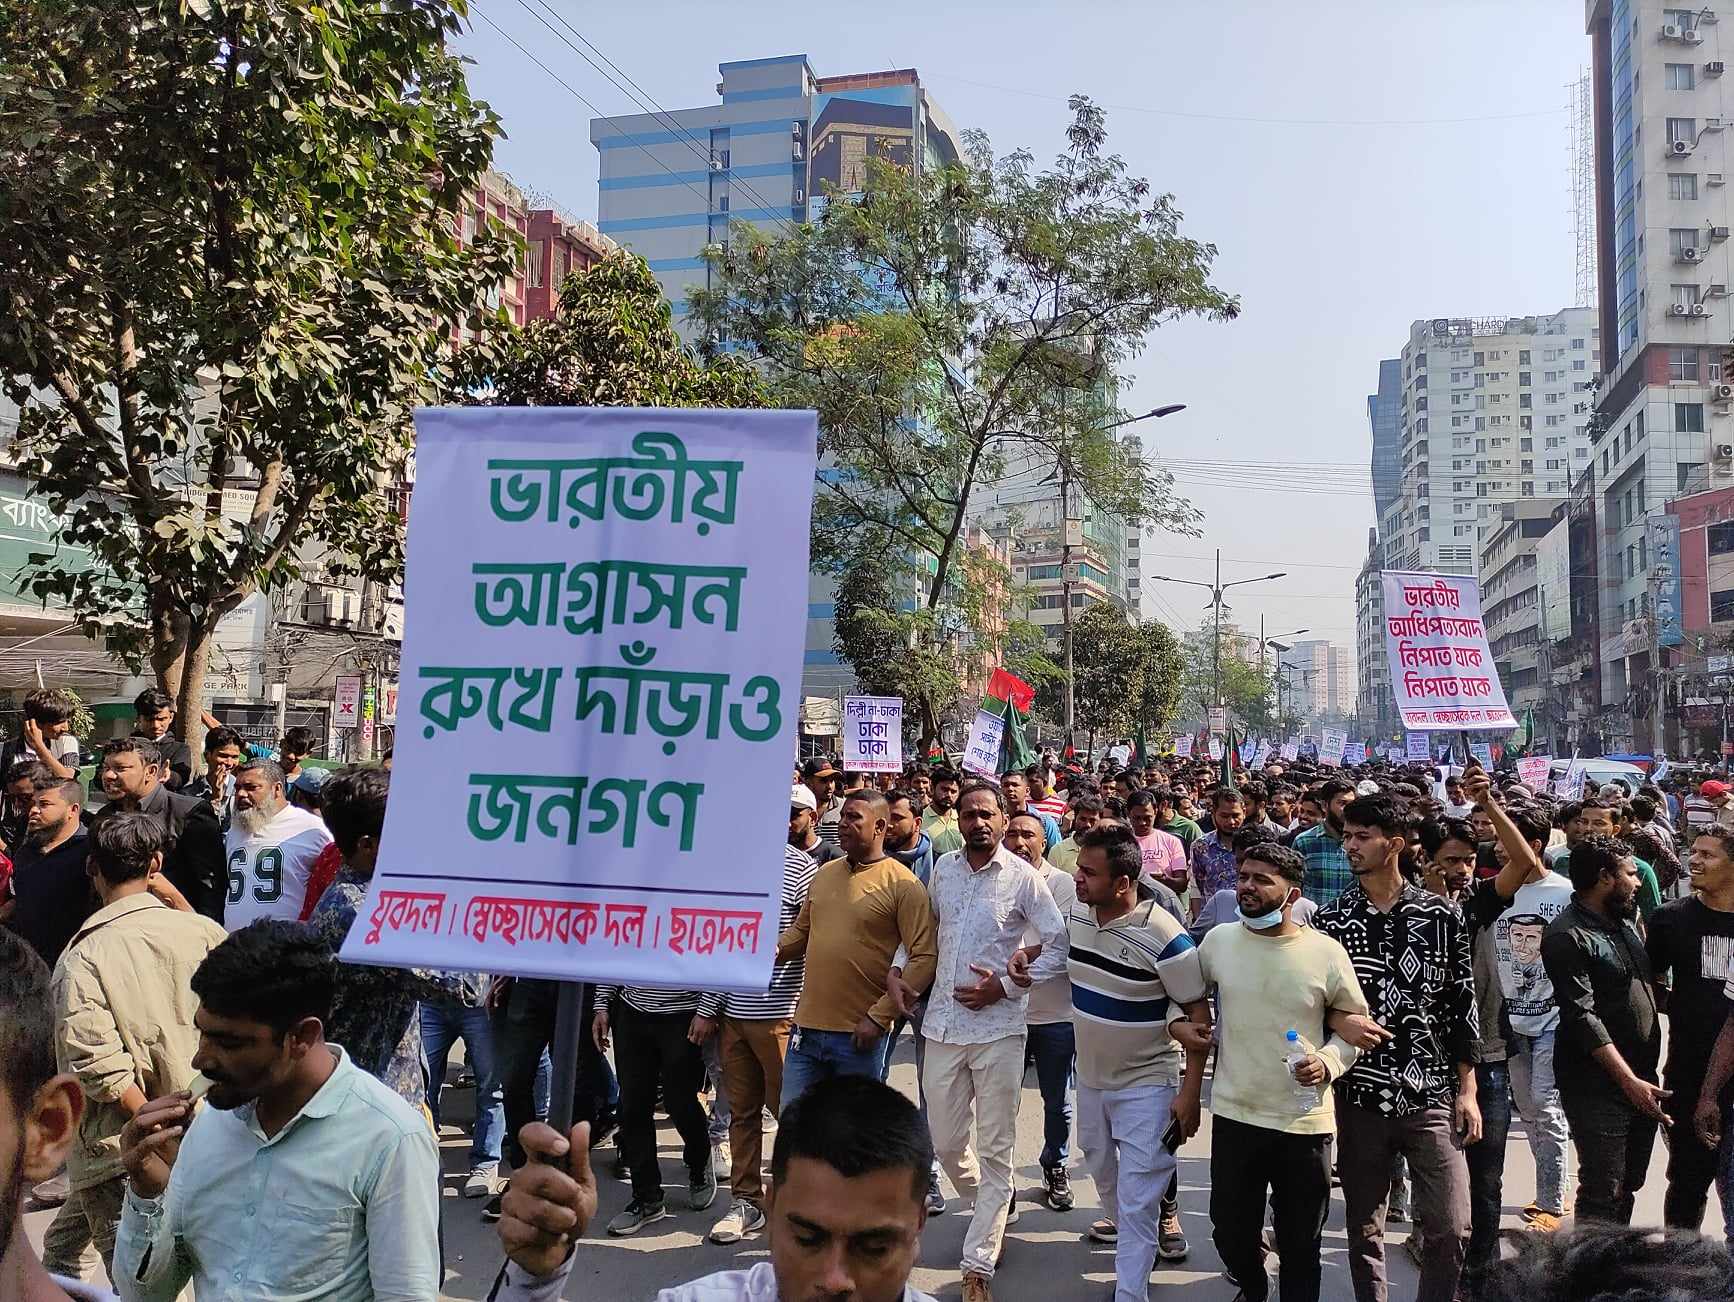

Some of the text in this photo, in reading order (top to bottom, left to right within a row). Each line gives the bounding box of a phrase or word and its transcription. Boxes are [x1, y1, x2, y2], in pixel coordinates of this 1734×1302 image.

[488, 431, 744, 536] ভারতীয়
[472, 560, 747, 635] আগ্রাসন
[1404, 580, 1460, 611] ভারতীয়
[1388, 610, 1482, 639] আধিপত্যবাদ
[1399, 640, 1482, 667] নিপাত যাক
[419, 667, 562, 739] রুখে
[576, 641, 782, 756] দাঁড়াও
[1404, 671, 1491, 698] নিপাত যাক
[847, 701, 866, 718] দিল্লী
[858, 721, 888, 737] ঢাকা
[858, 739, 888, 755] ঢাকা
[467, 774, 704, 852] জনগণ
[365, 890, 446, 945] যুবদল
[464, 896, 601, 945] স্বেচ্ছাসেবক
[604, 904, 648, 948] দল
[668, 907, 763, 955] ছাত্রদল
[1539, 902, 1554, 916] SHE
